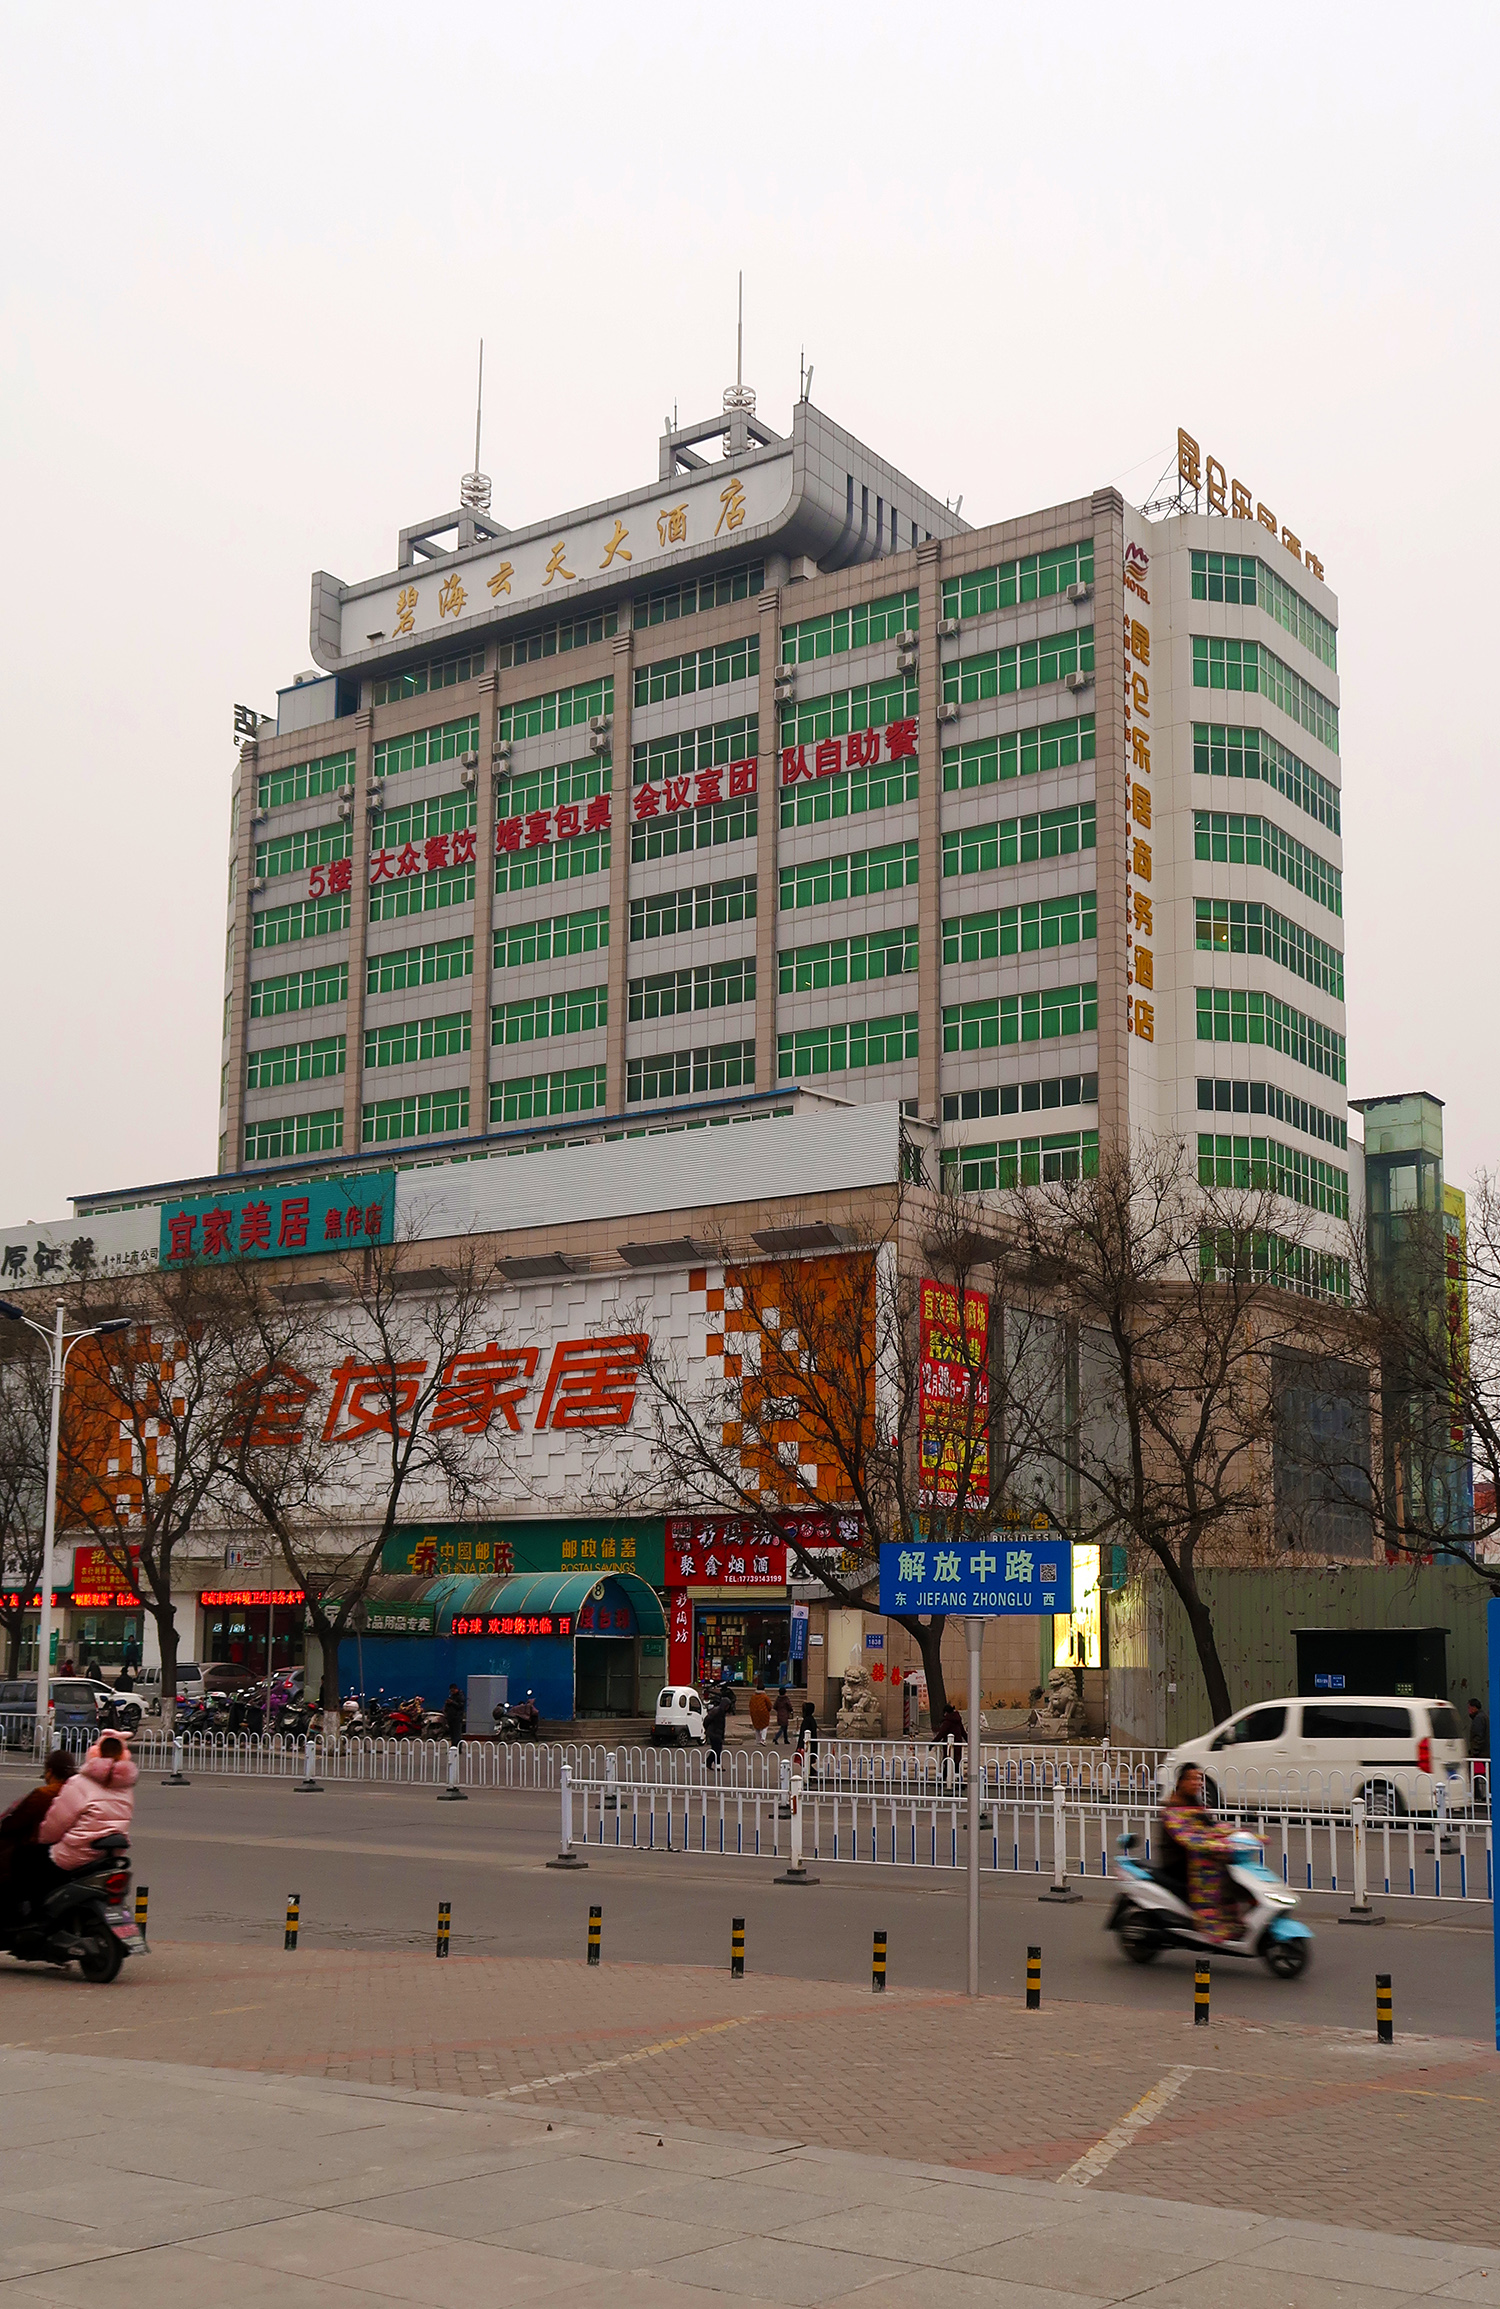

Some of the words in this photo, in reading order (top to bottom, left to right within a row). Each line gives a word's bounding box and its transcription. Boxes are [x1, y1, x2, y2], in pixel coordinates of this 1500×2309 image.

[392, 478, 747, 638] 碧海云天大酒店
[1123, 573, 1151, 604] HOTEL
[309, 858, 352, 899] 5楼
[370, 829, 477, 884] 大众餐饮
[496, 794, 612, 853] 婚宴包桌
[633, 757, 758, 821] 会议室团
[782, 717, 919, 786] 队自助餐
[1131, 619, 1155, 1043] 昆仑乐居商务酒店
[166, 1196, 310, 1262] 宜家美居
[323, 1201, 383, 1241] 焦作店
[223, 1333, 650, 1448] 全友家居
[440, 1541, 507, 1561] 中国邮
[562, 1537, 637, 1559] 邮政储蓄
[596, 1561, 636, 1572] SAVINGS
[680, 1554, 769, 1577] 聚鑫烟酒
[897, 1550, 1035, 1583] 解放中路
[895, 1591, 907, 1606] 东
[916, 1592, 967, 1606] JIEFANG
[972, 1592, 1032, 1606] ZHONGLU
[1042, 1592, 1056, 1606] 西
[488, 1616, 552, 1635] 欢迎您光临
[559, 1617, 571, 1634] 百
[674, 1592, 689, 1643] 彩陶坊
